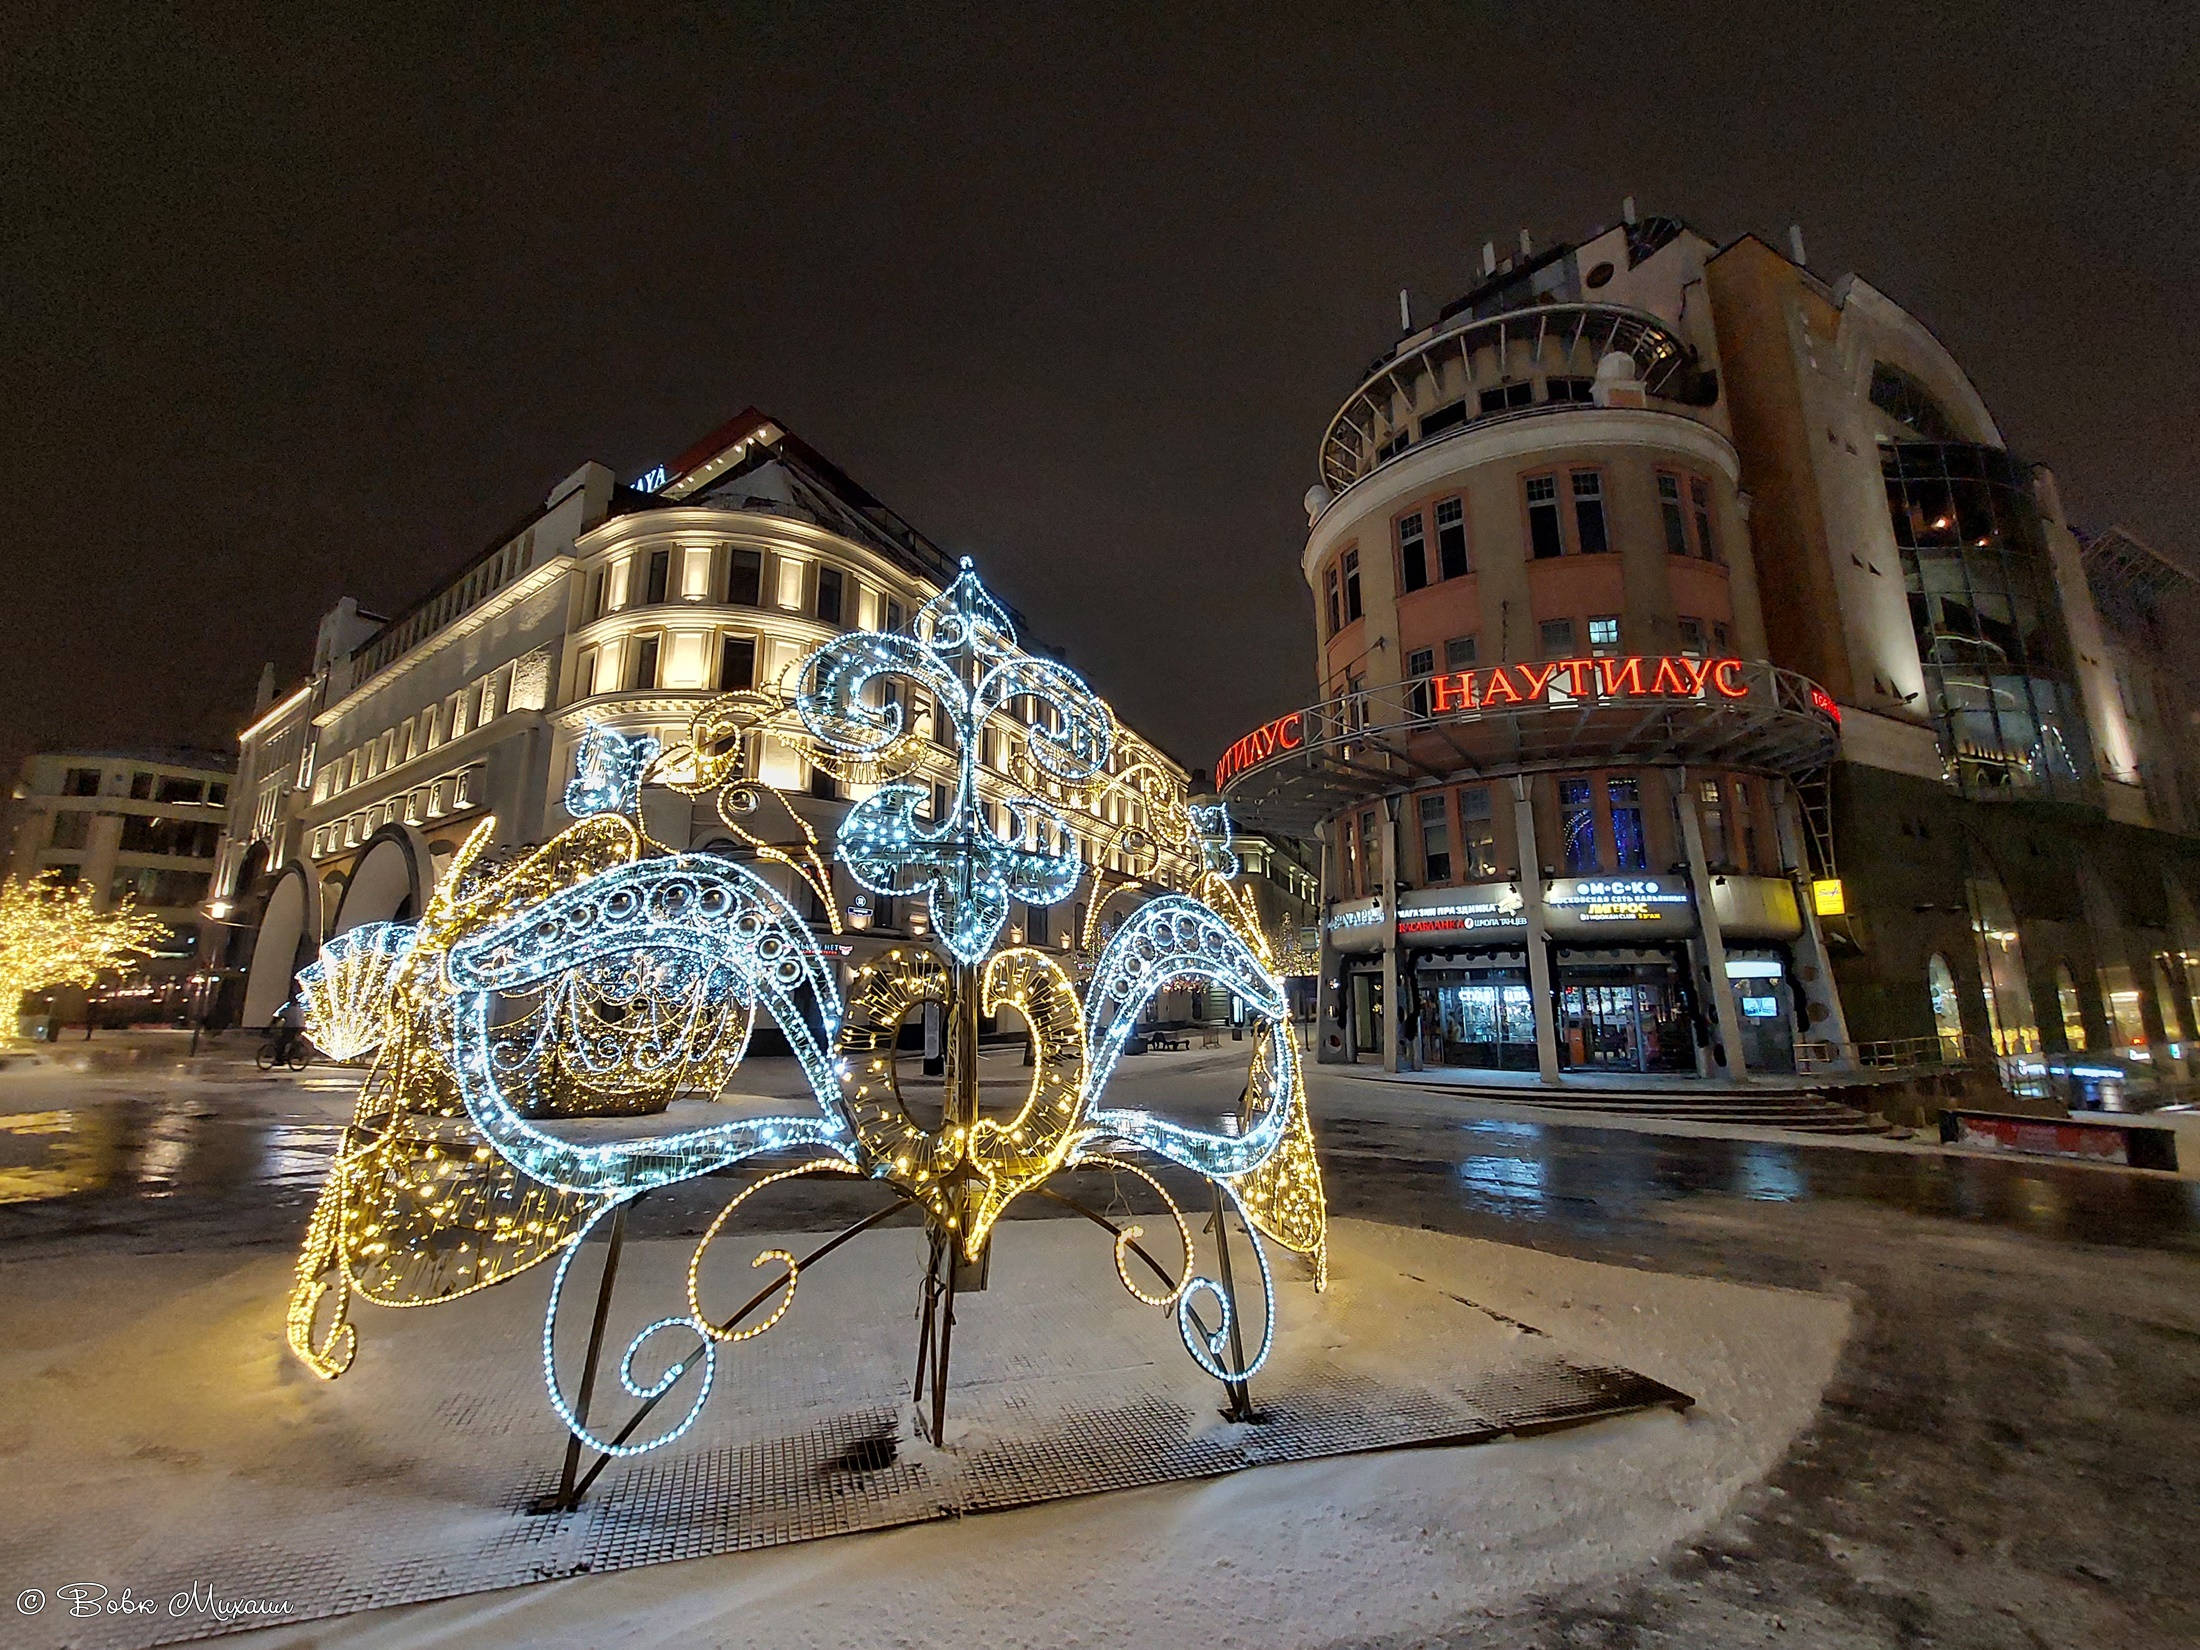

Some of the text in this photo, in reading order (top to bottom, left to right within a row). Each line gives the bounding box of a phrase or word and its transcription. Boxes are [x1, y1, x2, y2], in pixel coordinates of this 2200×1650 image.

[629, 464, 666, 493] AYA
[1431, 656, 1749, 713] НАУТИЛУС
[1437, 904, 1497, 916] ПРАЗДНИКА
[1474, 918, 1499, 927] ШКОЛА
